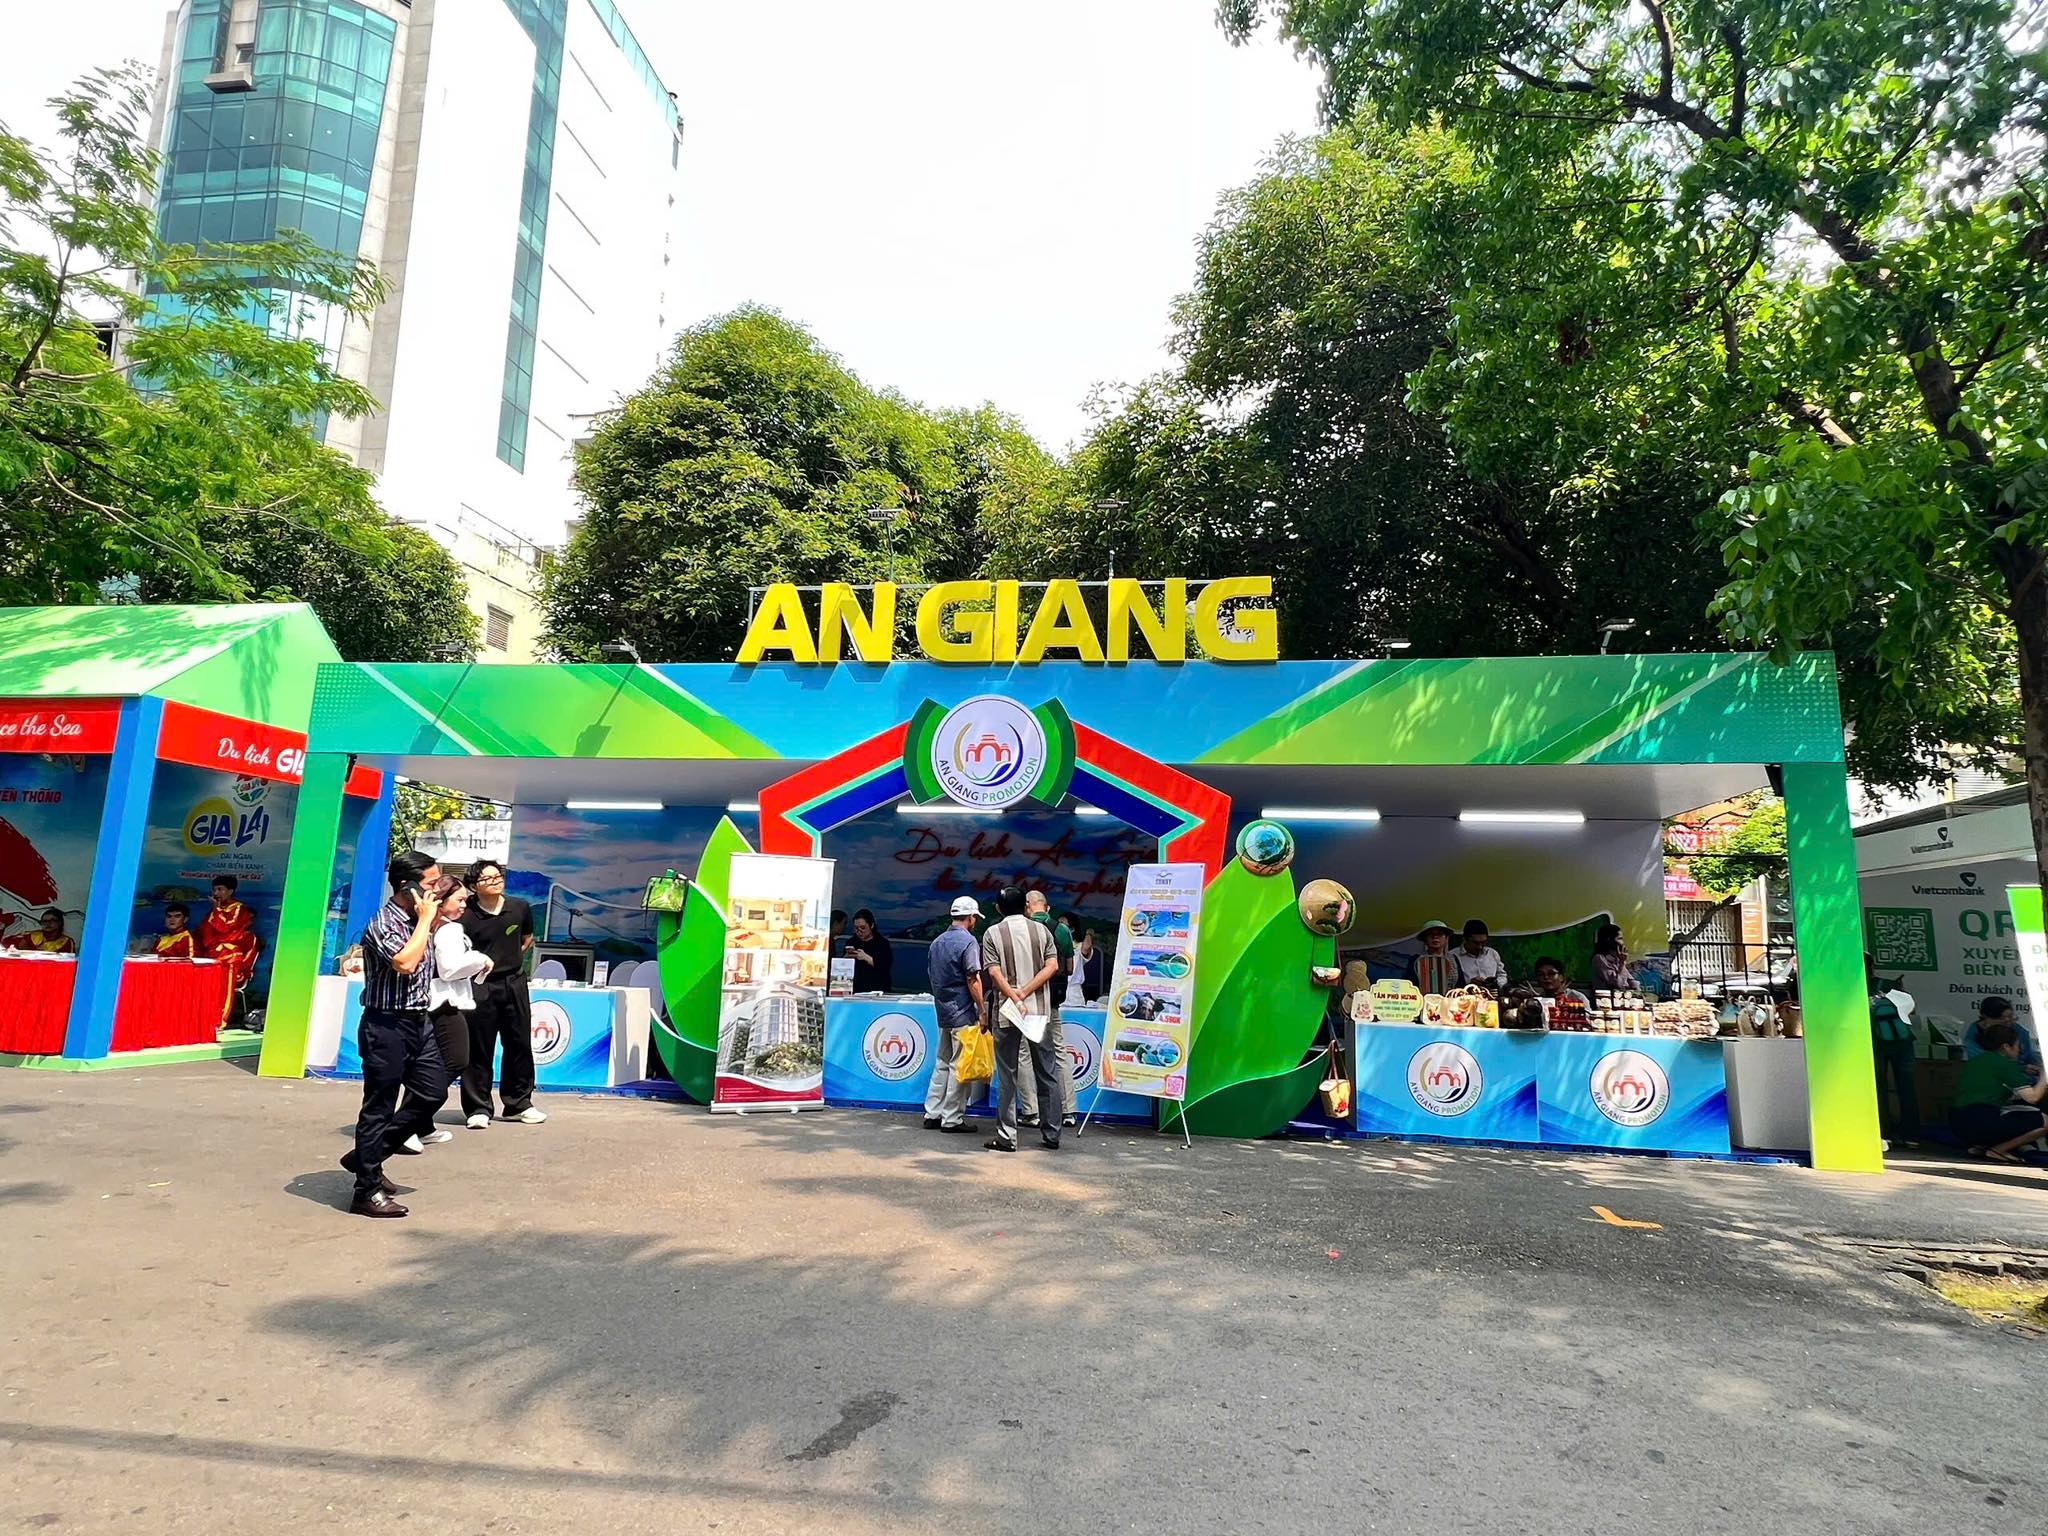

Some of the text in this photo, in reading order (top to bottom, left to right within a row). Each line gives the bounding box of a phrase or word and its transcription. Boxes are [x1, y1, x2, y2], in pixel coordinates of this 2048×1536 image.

[735, 576, 1278, 664] AN GIANG
[20, 714, 47, 736] the
[49, 713, 83, 737] Sea
[217, 738, 241, 759] Du
[243, 744, 271, 765] lịch
[939, 757, 1039, 802] AN GIANG PROMOTION
[190, 805, 270, 848] GIA LAI
[894, 828, 960, 864] Du
[968, 832, 1013, 861] lịch
[1097, 831, 1158, 865] Gia
[1912, 884, 1985, 896] Vietcombank
[1963, 961, 2006, 976] BIÊN
[1949, 983, 1973, 994] Đón
[1977, 984, 2013, 995] khách
[869, 1060, 889, 1078] GIANG
[889, 1051, 924, 1079] PROMOTION
[1074, 1063, 1100, 1090] OMOTION
[1416, 1094, 1440, 1113] GIANG
[1441, 1086, 1480, 1114] PROMOTION
[1600, 1103, 1626, 1122] GIANG
[1627, 1094, 1667, 1124] PROMOTION
